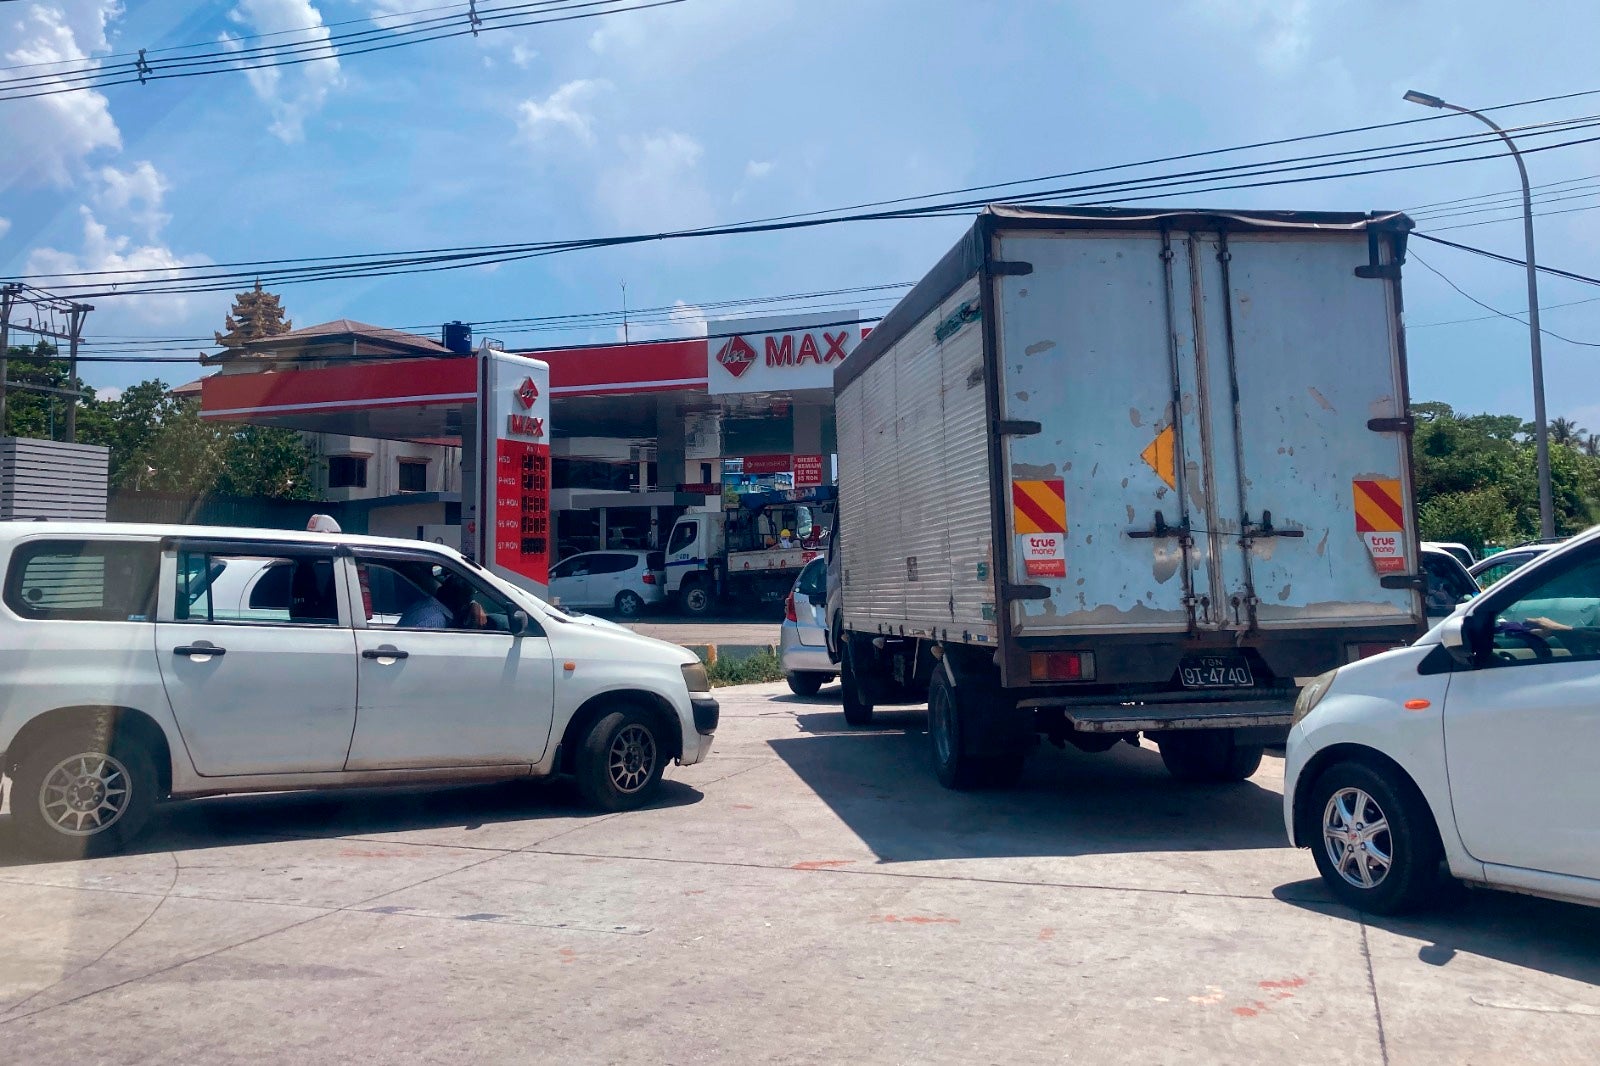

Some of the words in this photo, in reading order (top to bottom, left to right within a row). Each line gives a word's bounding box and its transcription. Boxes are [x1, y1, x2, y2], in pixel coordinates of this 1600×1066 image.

[765, 331, 849, 367] MAX
[510, 413, 544, 437] MAX
[506, 498, 519, 507] RON
[506, 520, 519, 528] RON
[505, 541, 518, 550] RON
[1030, 537, 1056, 548] true
[1371, 536, 1396, 546] true
[1031, 547, 1057, 557] money
[1372, 546, 1396, 555] money
